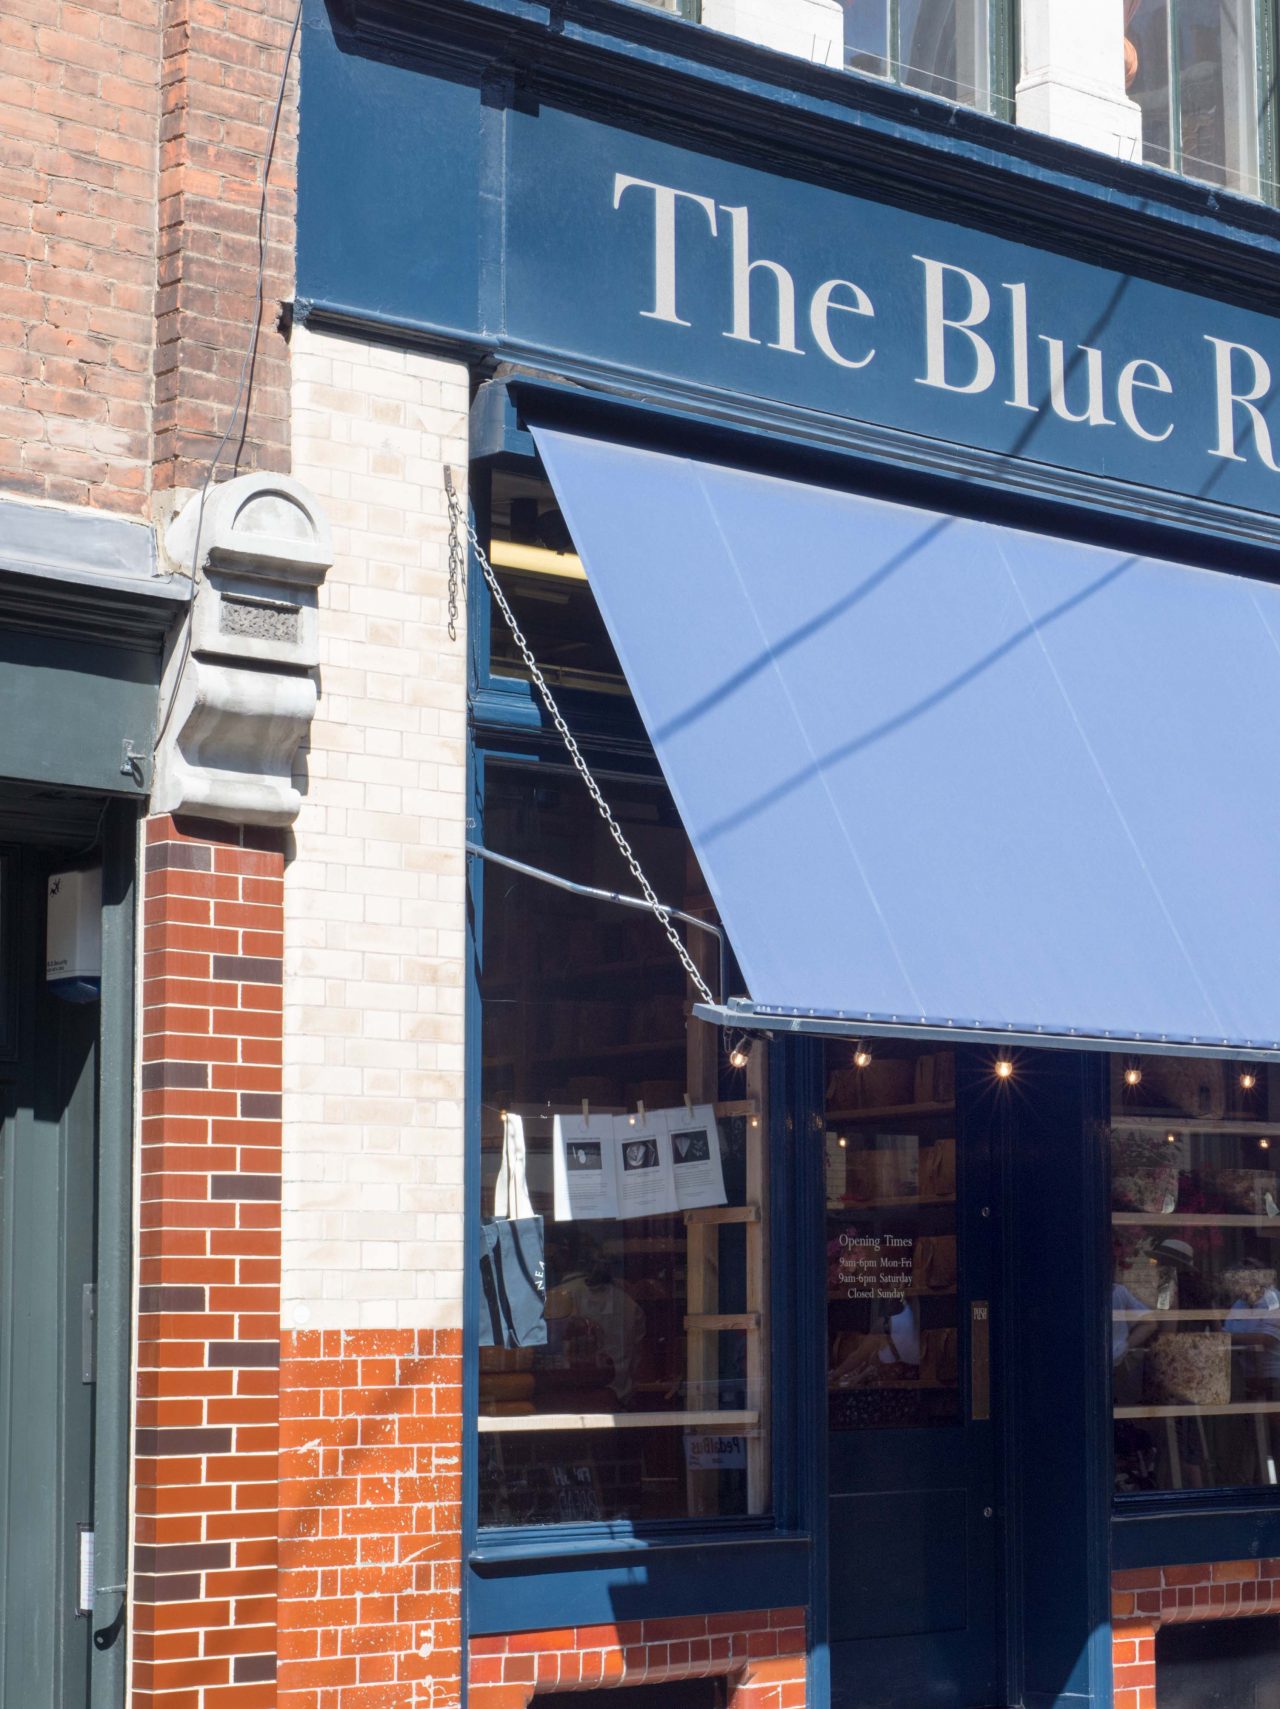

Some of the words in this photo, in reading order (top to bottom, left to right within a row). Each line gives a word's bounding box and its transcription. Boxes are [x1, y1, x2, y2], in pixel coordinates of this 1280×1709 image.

[612, 172, 877, 370] The
[911, 253, 1176, 443] Blue
[838, 1233, 881, 1252] Opening
[884, 1234, 913, 1247] Times
[838, 1257, 877, 1271] 9am-6pm
[880, 1257, 913, 1268] Mon-Fri
[838, 1272, 877, 1287] 9am-6pm
[879, 1272, 913, 1286] Saturday
[847, 1288, 874, 1300] Closed
[877, 1288, 905, 1302] Sunday
